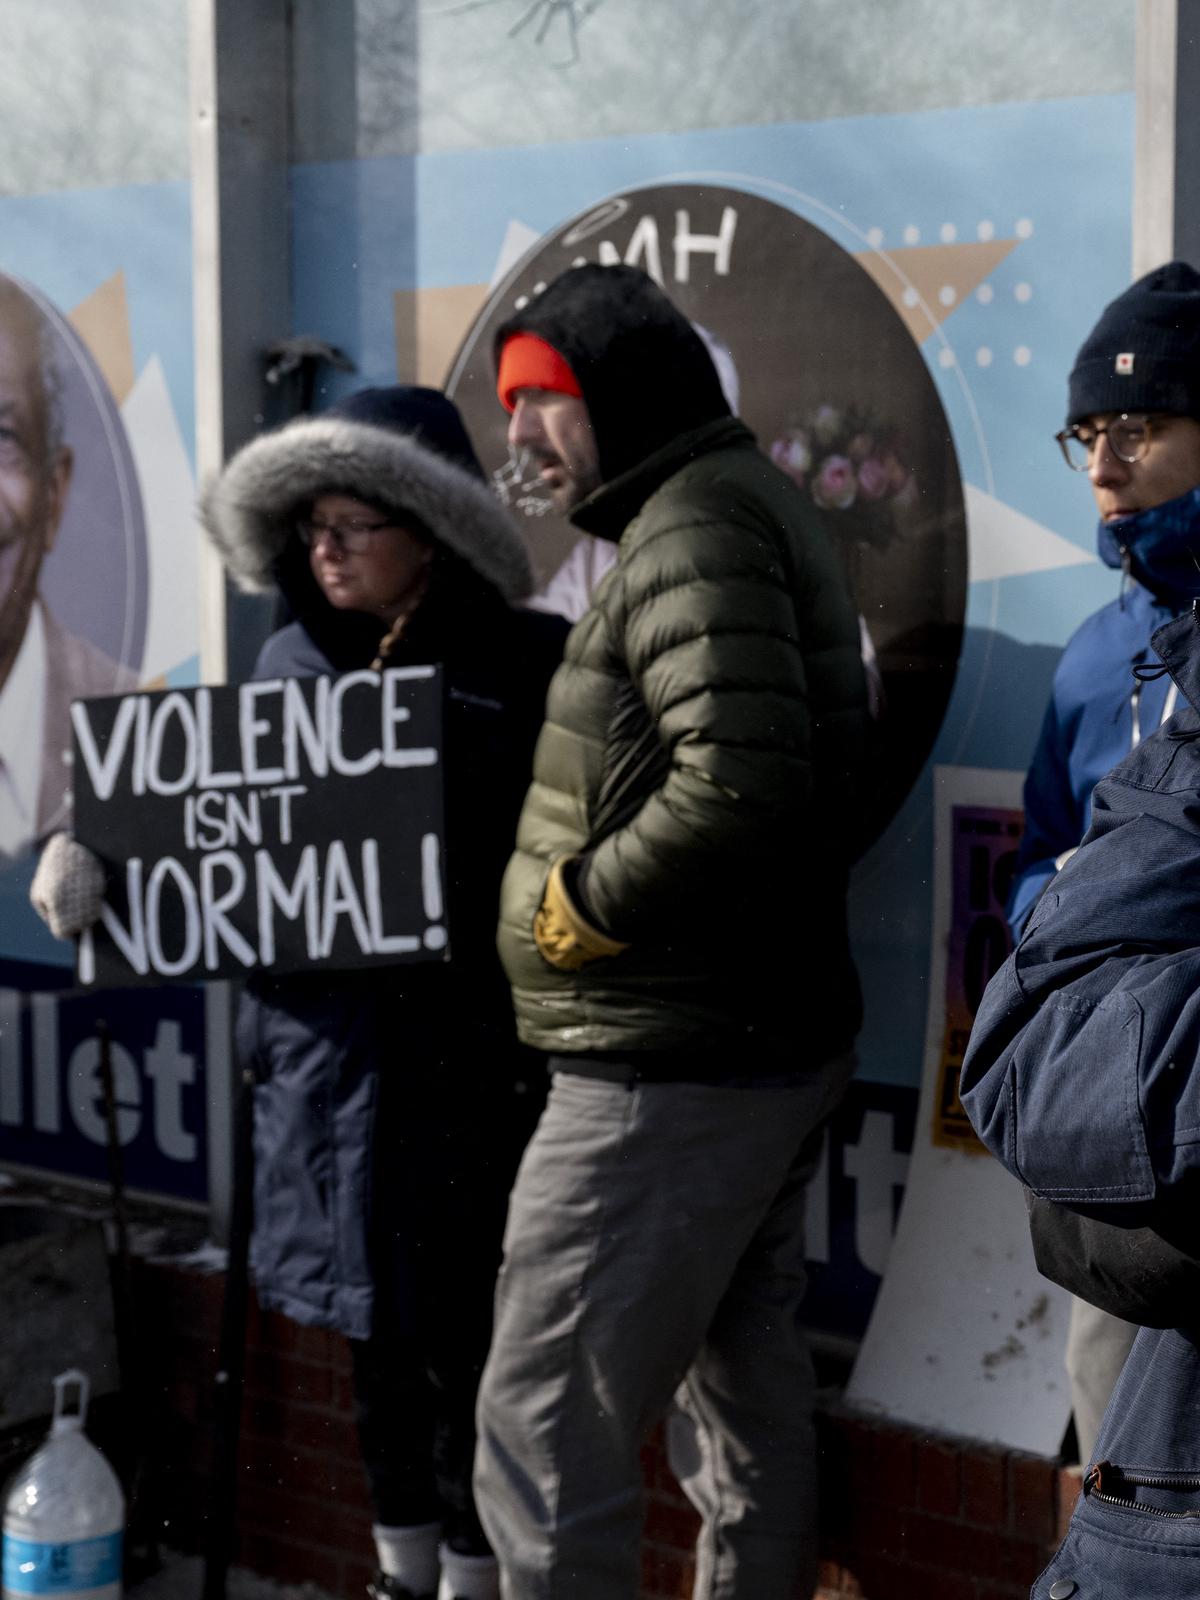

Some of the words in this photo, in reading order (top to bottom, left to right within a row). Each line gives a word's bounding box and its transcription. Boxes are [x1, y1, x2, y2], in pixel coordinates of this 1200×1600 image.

[71, 665, 438, 800] VIOLENCE
[183, 786, 308, 850] ISN'T
[78, 833, 448, 984] NORMAL!
